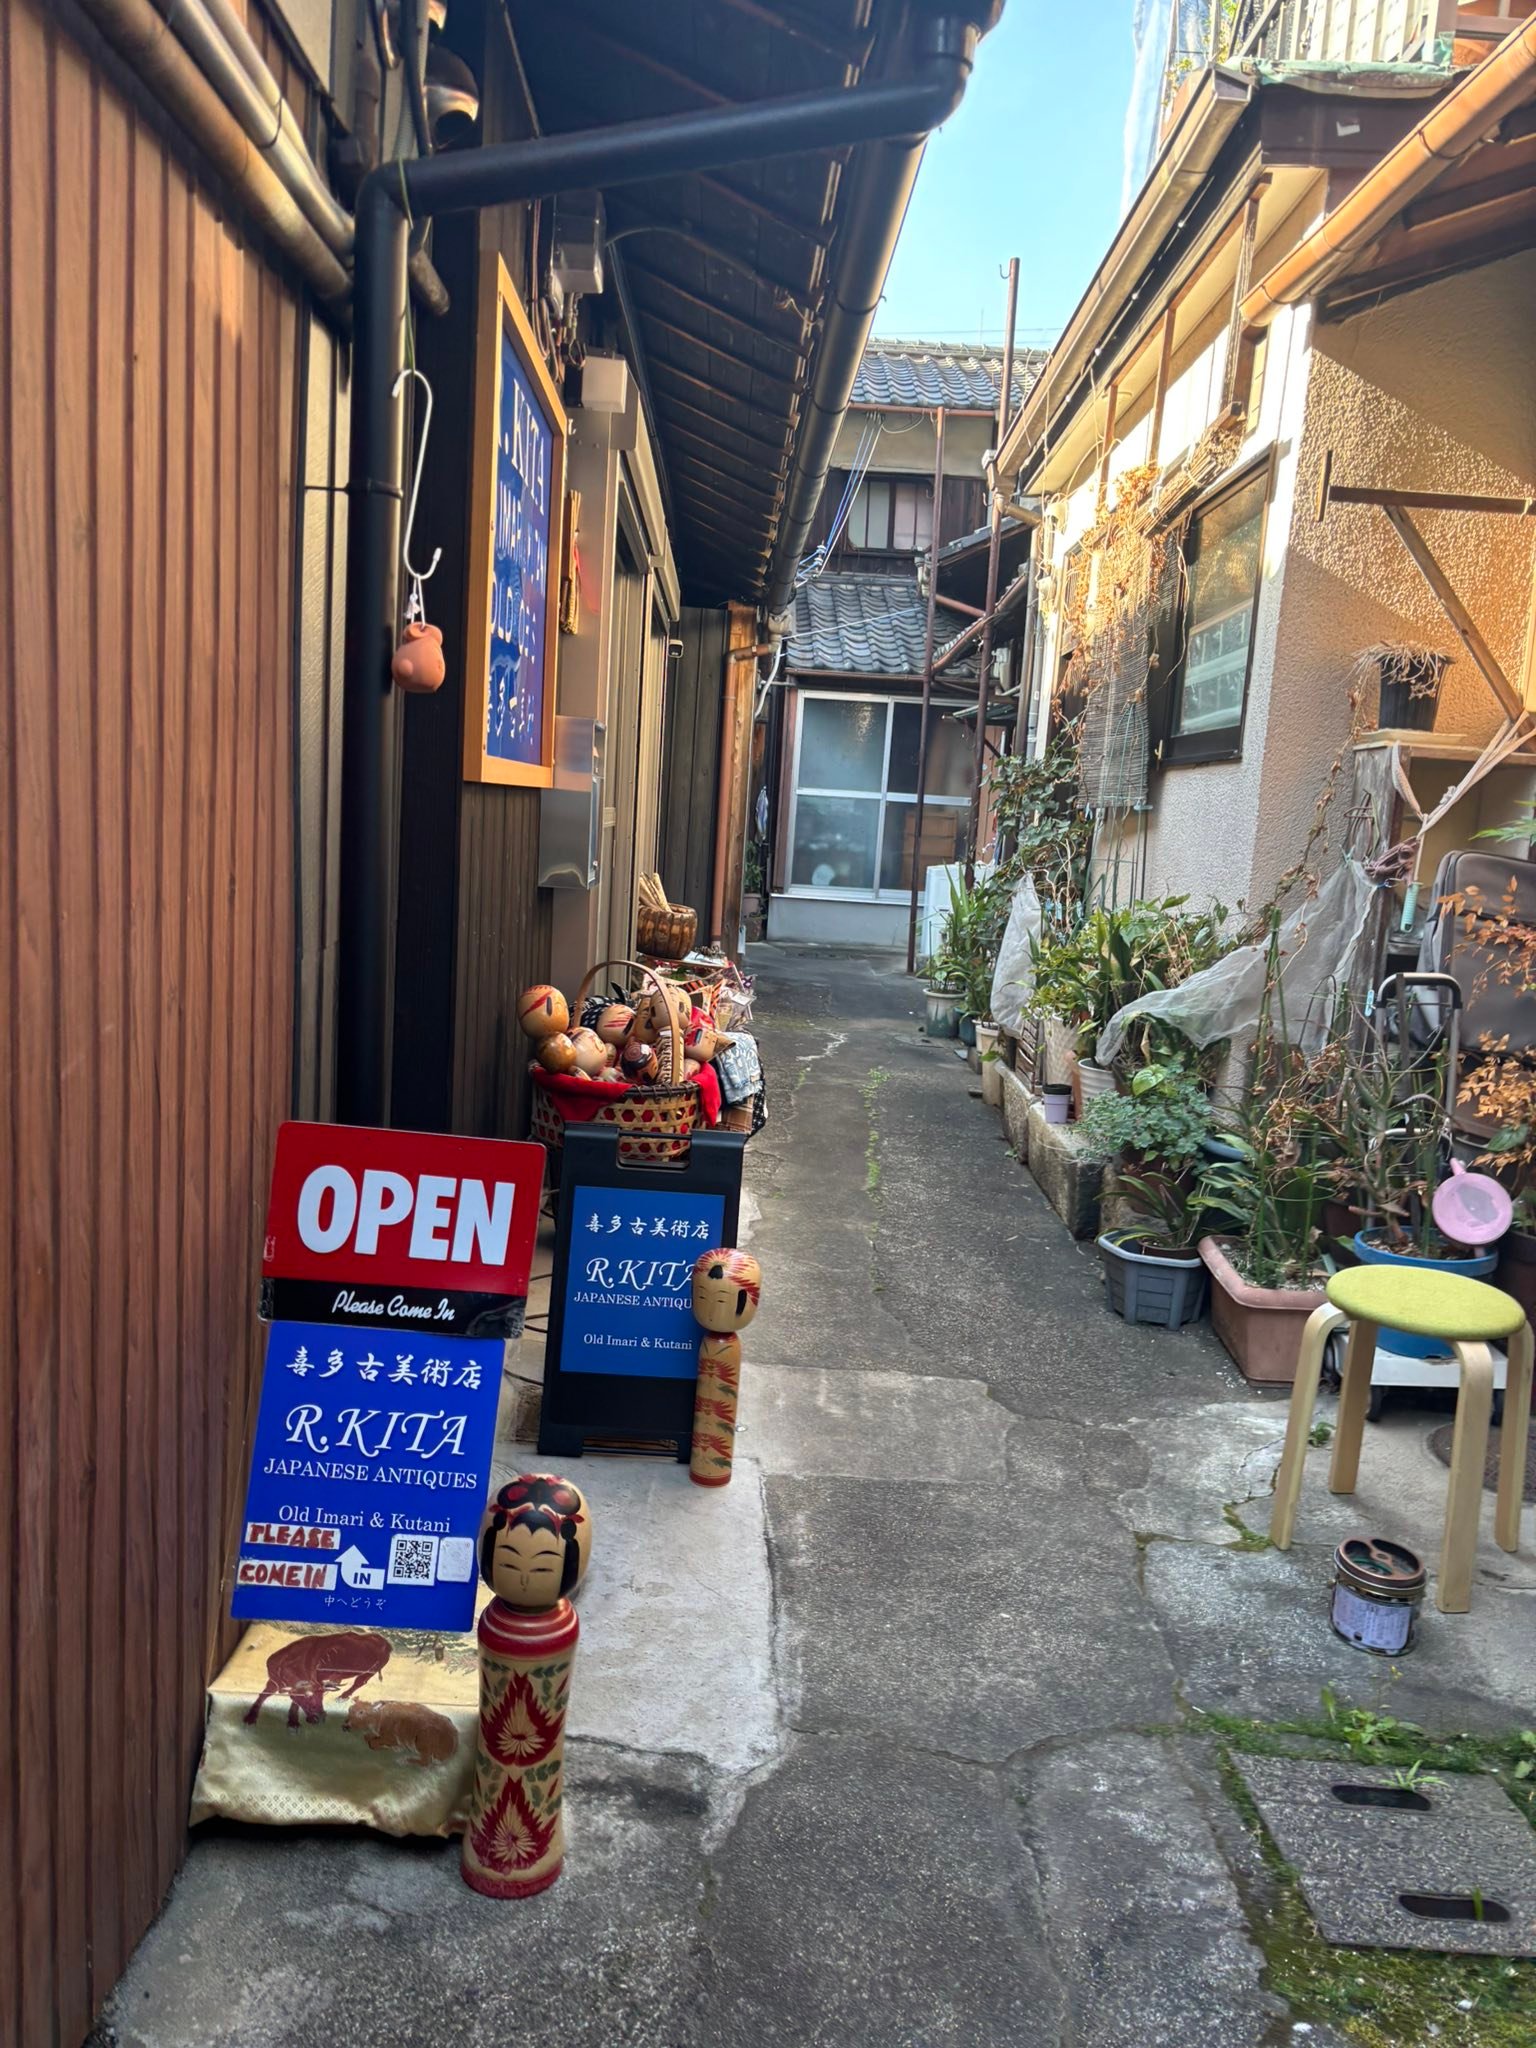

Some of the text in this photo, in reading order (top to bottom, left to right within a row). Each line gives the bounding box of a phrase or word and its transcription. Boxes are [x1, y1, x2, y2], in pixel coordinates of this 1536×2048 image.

[297, 1164, 516, 1266] OPEN
[585, 1212, 710, 1240] 喜多古美術店
[332, 1289, 455, 1321] Please Come In
[574, 1291, 692, 1310] JAPANESE ANTIQU
[583, 1333, 693, 1350] Old Imari & Kutani
[286, 1345, 483, 1390] 喜多古美術店
[285, 1404, 468, 1459] R.KITA
[264, 1458, 477, 1489] JAPANESE ANTIQUES
[279, 1505, 450, 1533] Old Imari & Kutani
[249, 1523, 335, 1549] PLEASE
[353, 1572, 371, 1585] IN
[324, 1594, 386, 1611] 中へどうぞ
